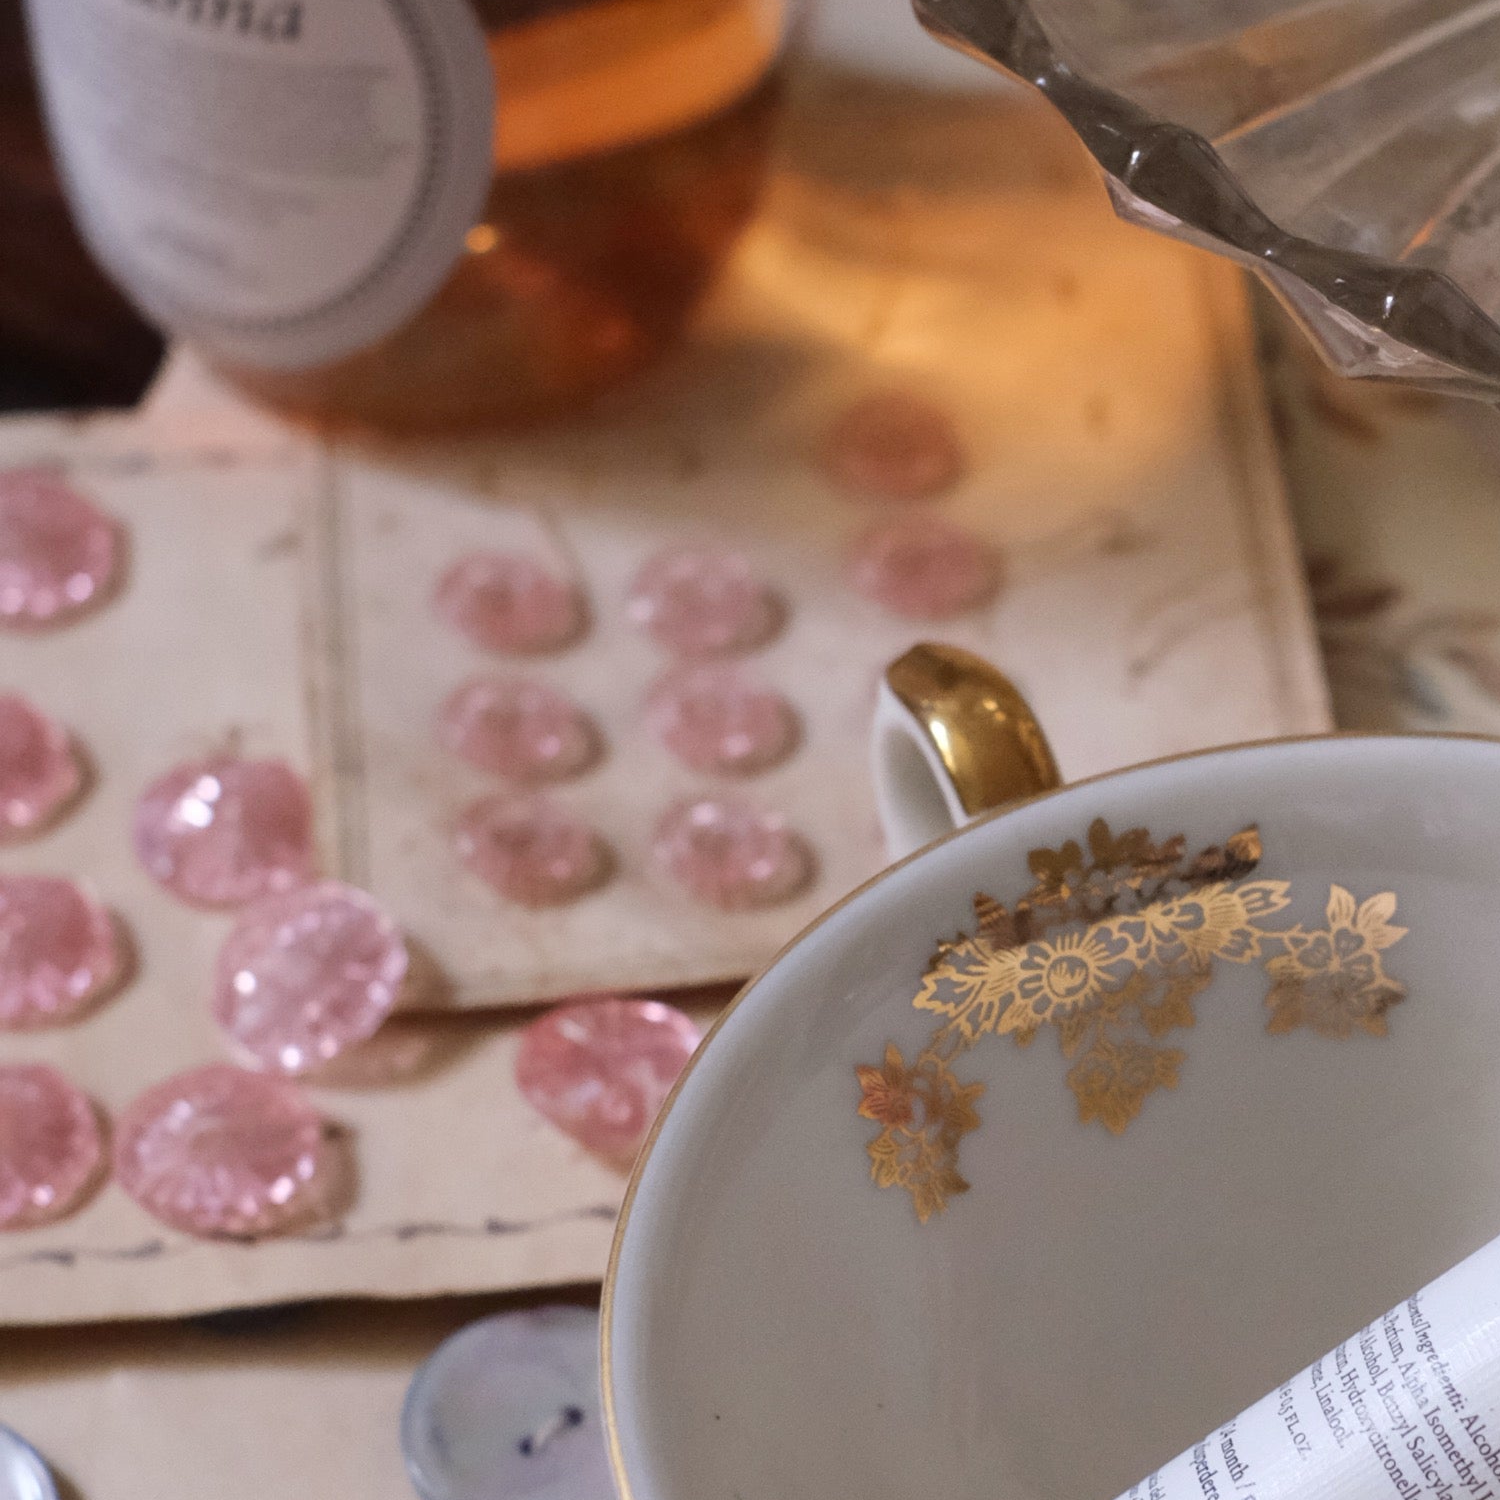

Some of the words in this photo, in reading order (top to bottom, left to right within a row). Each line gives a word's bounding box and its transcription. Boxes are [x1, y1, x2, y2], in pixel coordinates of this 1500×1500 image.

[1314, 1381, 1355, 1450] Linalool.
[1359, 1336, 1389, 1387] Alcohol,
[1376, 1379, 1419, 1440] Benzyl
[1383, 1315, 1405, 1365] Parfum,
[1397, 1361, 1430, 1411] Alpha
[1422, 1405, 1488, 1496] Isomethyl
[1220, 1437, 1250, 1484] month
[1234, 1481, 1257, 1491] /
